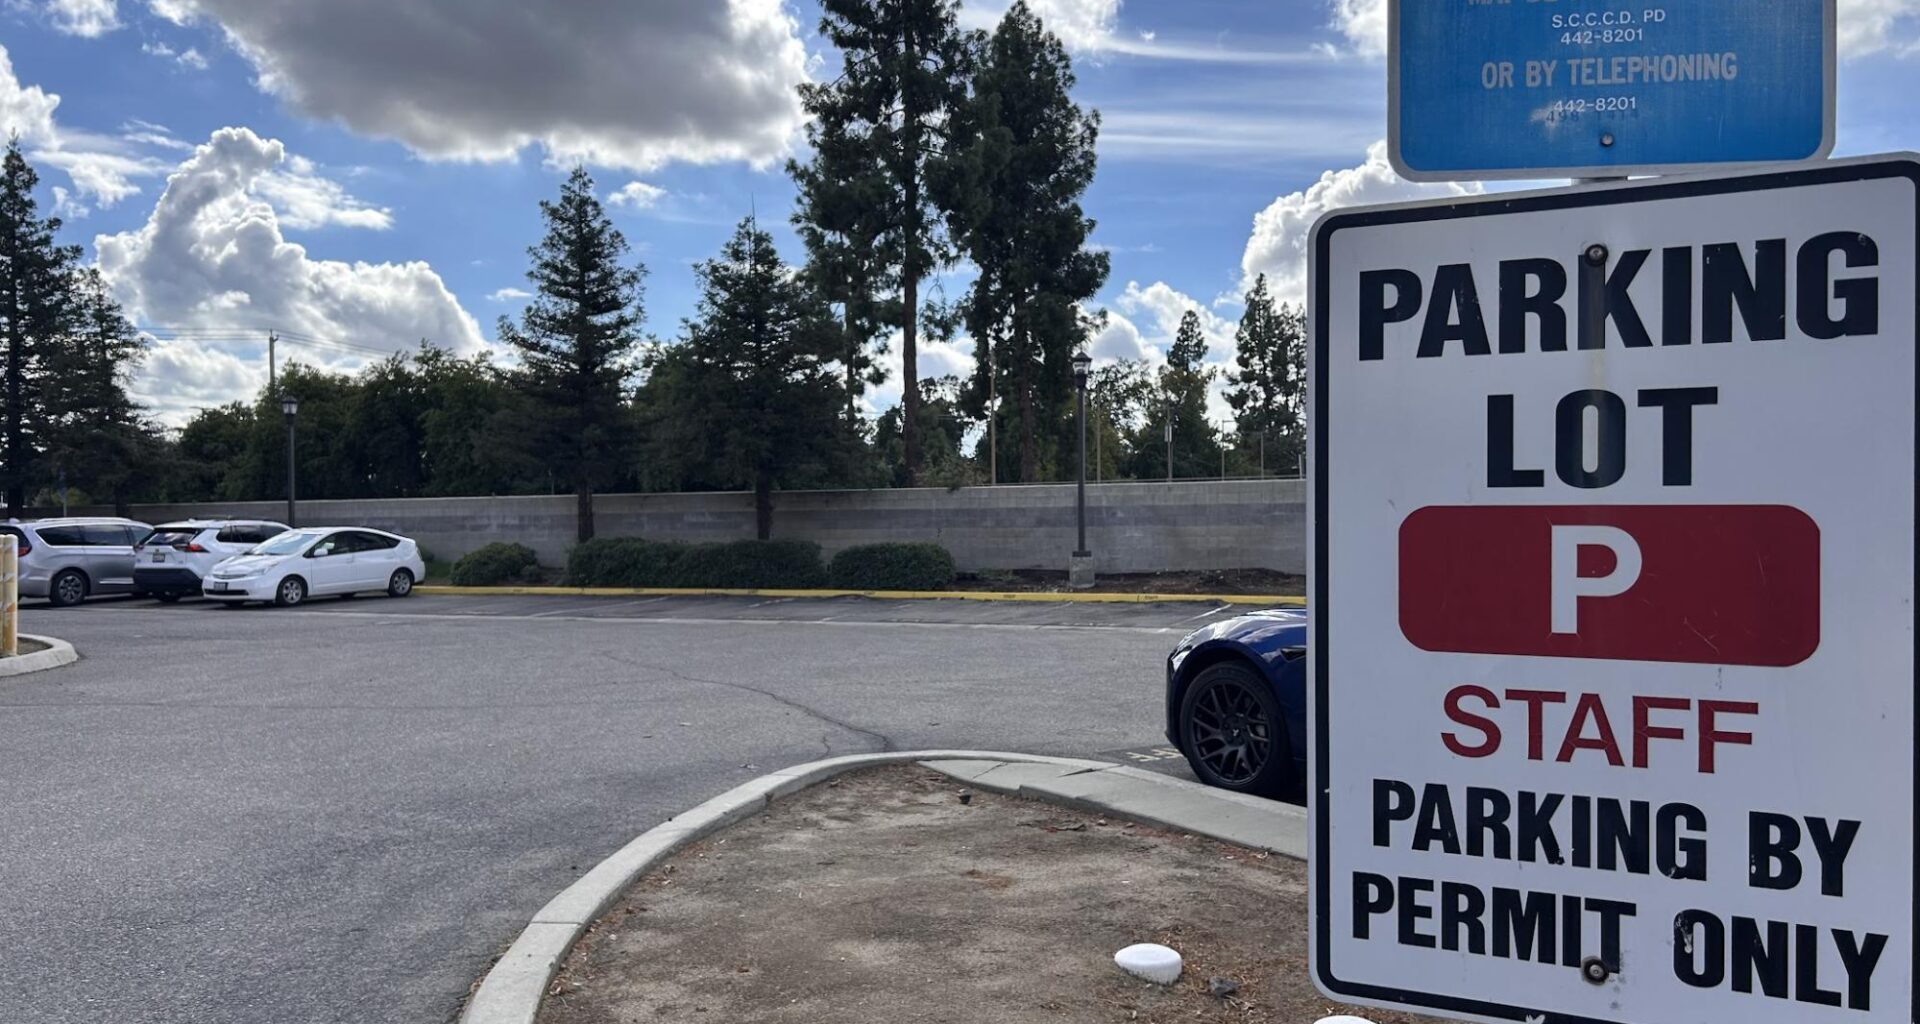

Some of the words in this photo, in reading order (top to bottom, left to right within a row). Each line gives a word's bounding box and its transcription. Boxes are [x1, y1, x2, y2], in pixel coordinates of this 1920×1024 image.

[1551, 11, 1636, 28] S.C.C.C.D.
[1643, 9, 1666, 23] PD
[1560, 28, 1643, 45] 442-8201
[1481, 62, 1514, 89] OR
[1525, 60, 1556, 88] BY
[1567, 52, 1737, 86] TELEPHONING
[1553, 96, 1637, 113] 442-8201
[1358, 231, 1879, 361] PARKING
[1486, 386, 1718, 489] LOT
[1550, 525, 1643, 634] P
[1440, 684, 1759, 774] STAFF
[1372, 778, 1708, 881] PARKING
[1748, 810, 1862, 898] BY
[1351, 870, 1637, 974] PERMIT
[1672, 909, 1890, 1011] ONLY
